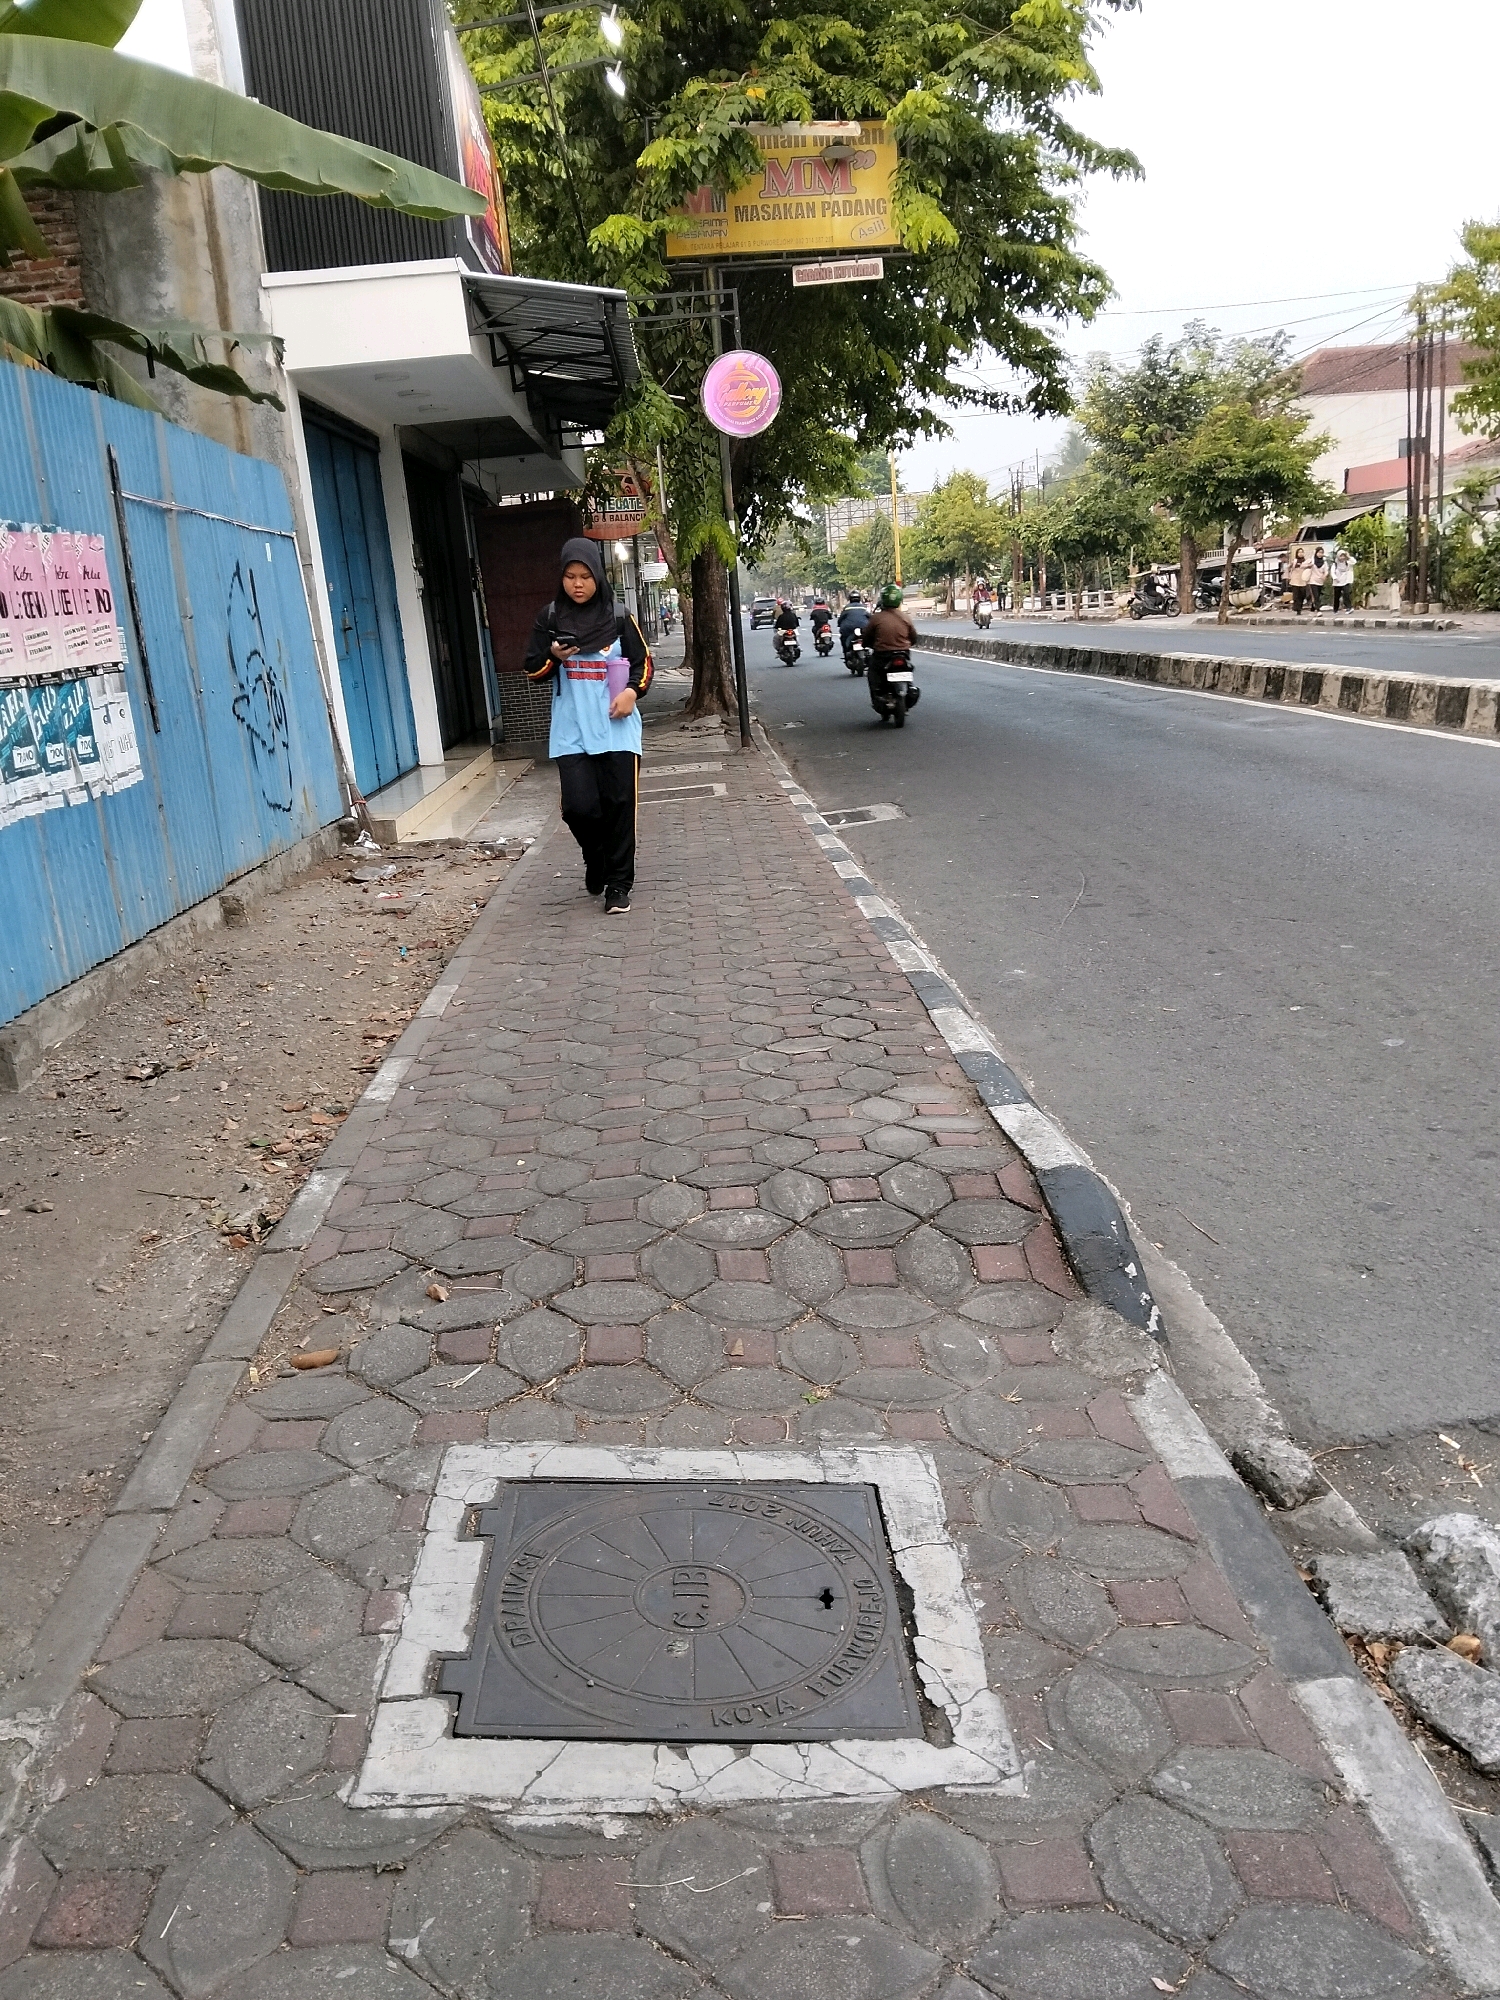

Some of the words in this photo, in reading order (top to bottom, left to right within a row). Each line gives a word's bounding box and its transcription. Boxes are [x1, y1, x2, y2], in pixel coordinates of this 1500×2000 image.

[734, 202, 816, 222] MASAKAN
[821, 198, 887, 217] PADANG
[859, 219, 886, 239] Asli!
[795, 267, 833, 283] CABANG
[834, 263, 880, 279] KUTOARJO
[708, 1494, 784, 1518] 2017
[786, 1517, 857, 1566] TAHUN
[501, 1547, 549, 1648] DRAINASE
[710, 1696, 798, 1727] KOTA
[806, 1578, 884, 1700] PURWOREJO
